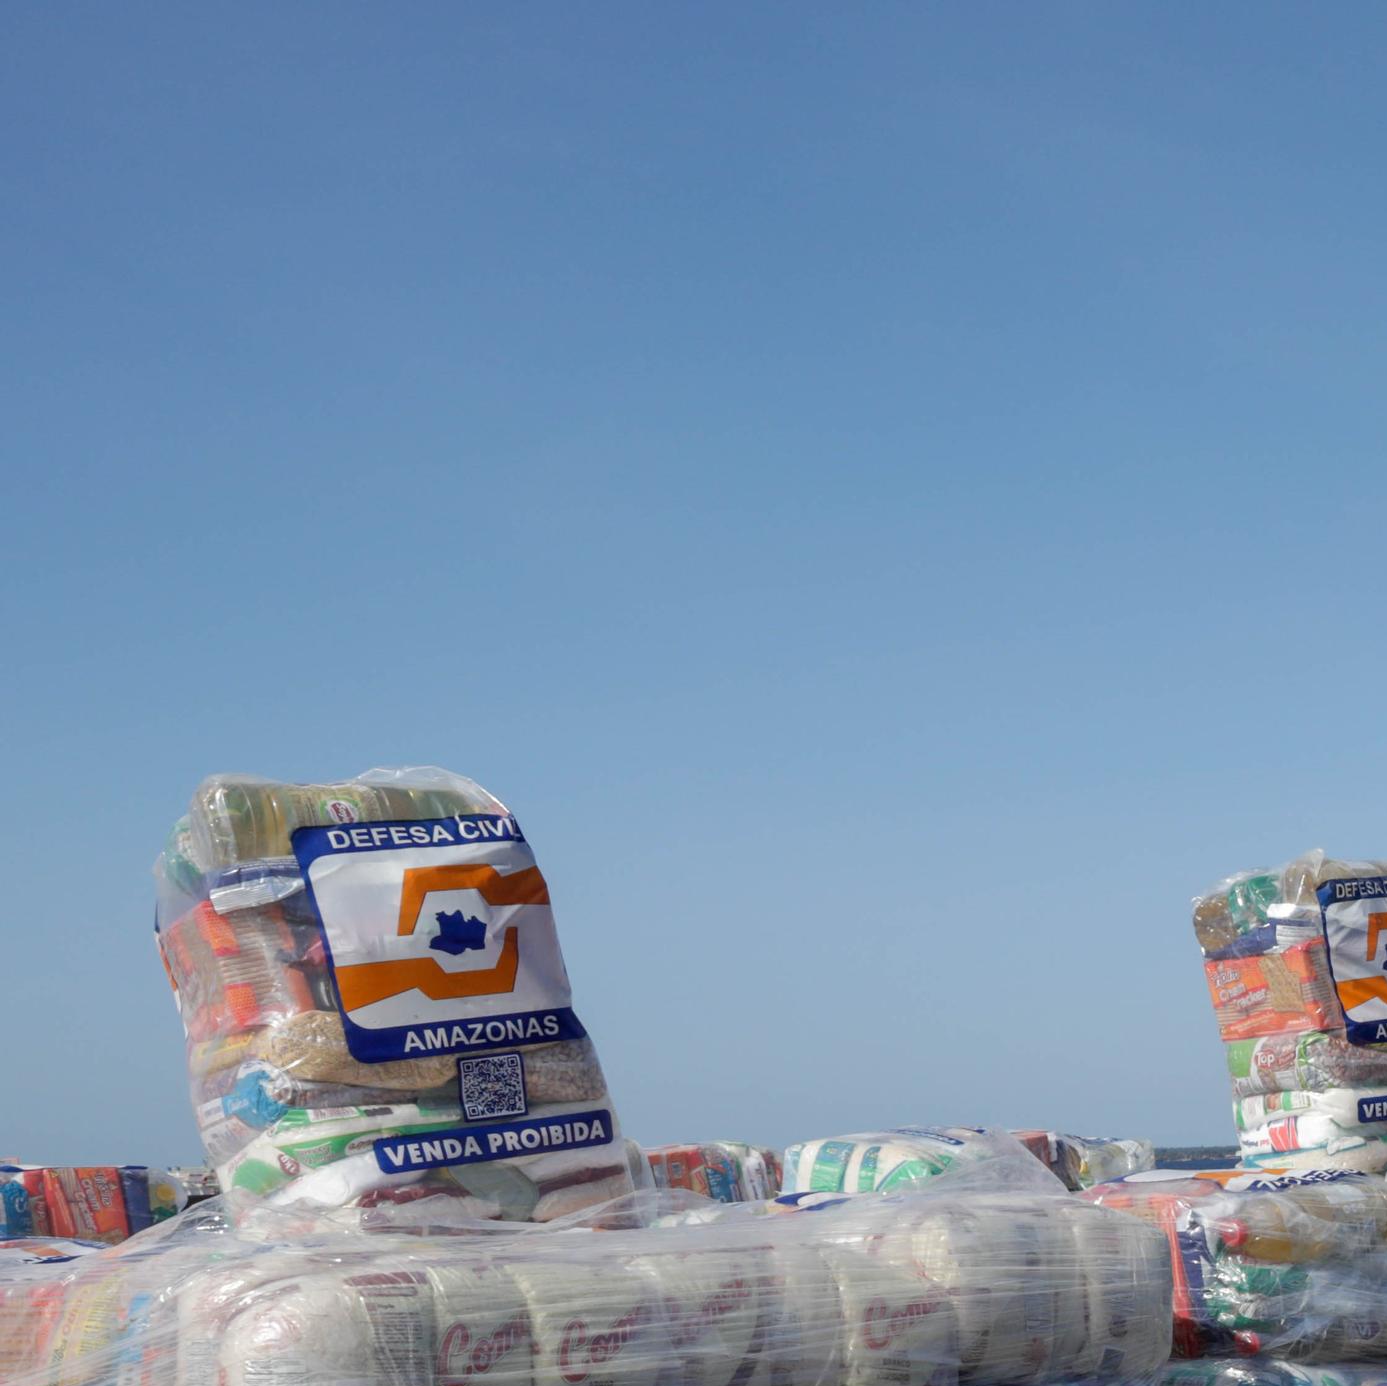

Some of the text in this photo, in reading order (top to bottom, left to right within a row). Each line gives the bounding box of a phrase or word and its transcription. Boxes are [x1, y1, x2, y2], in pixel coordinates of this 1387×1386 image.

[327, 815, 522, 850] DEFESA CIVIL
[1335, 879, 1384, 899] DEFESA
[403, 1014, 560, 1053] AMAZONAS
[382, 1135, 481, 1167] VENDA
[489, 1119, 606, 1156] PROIBIDA
